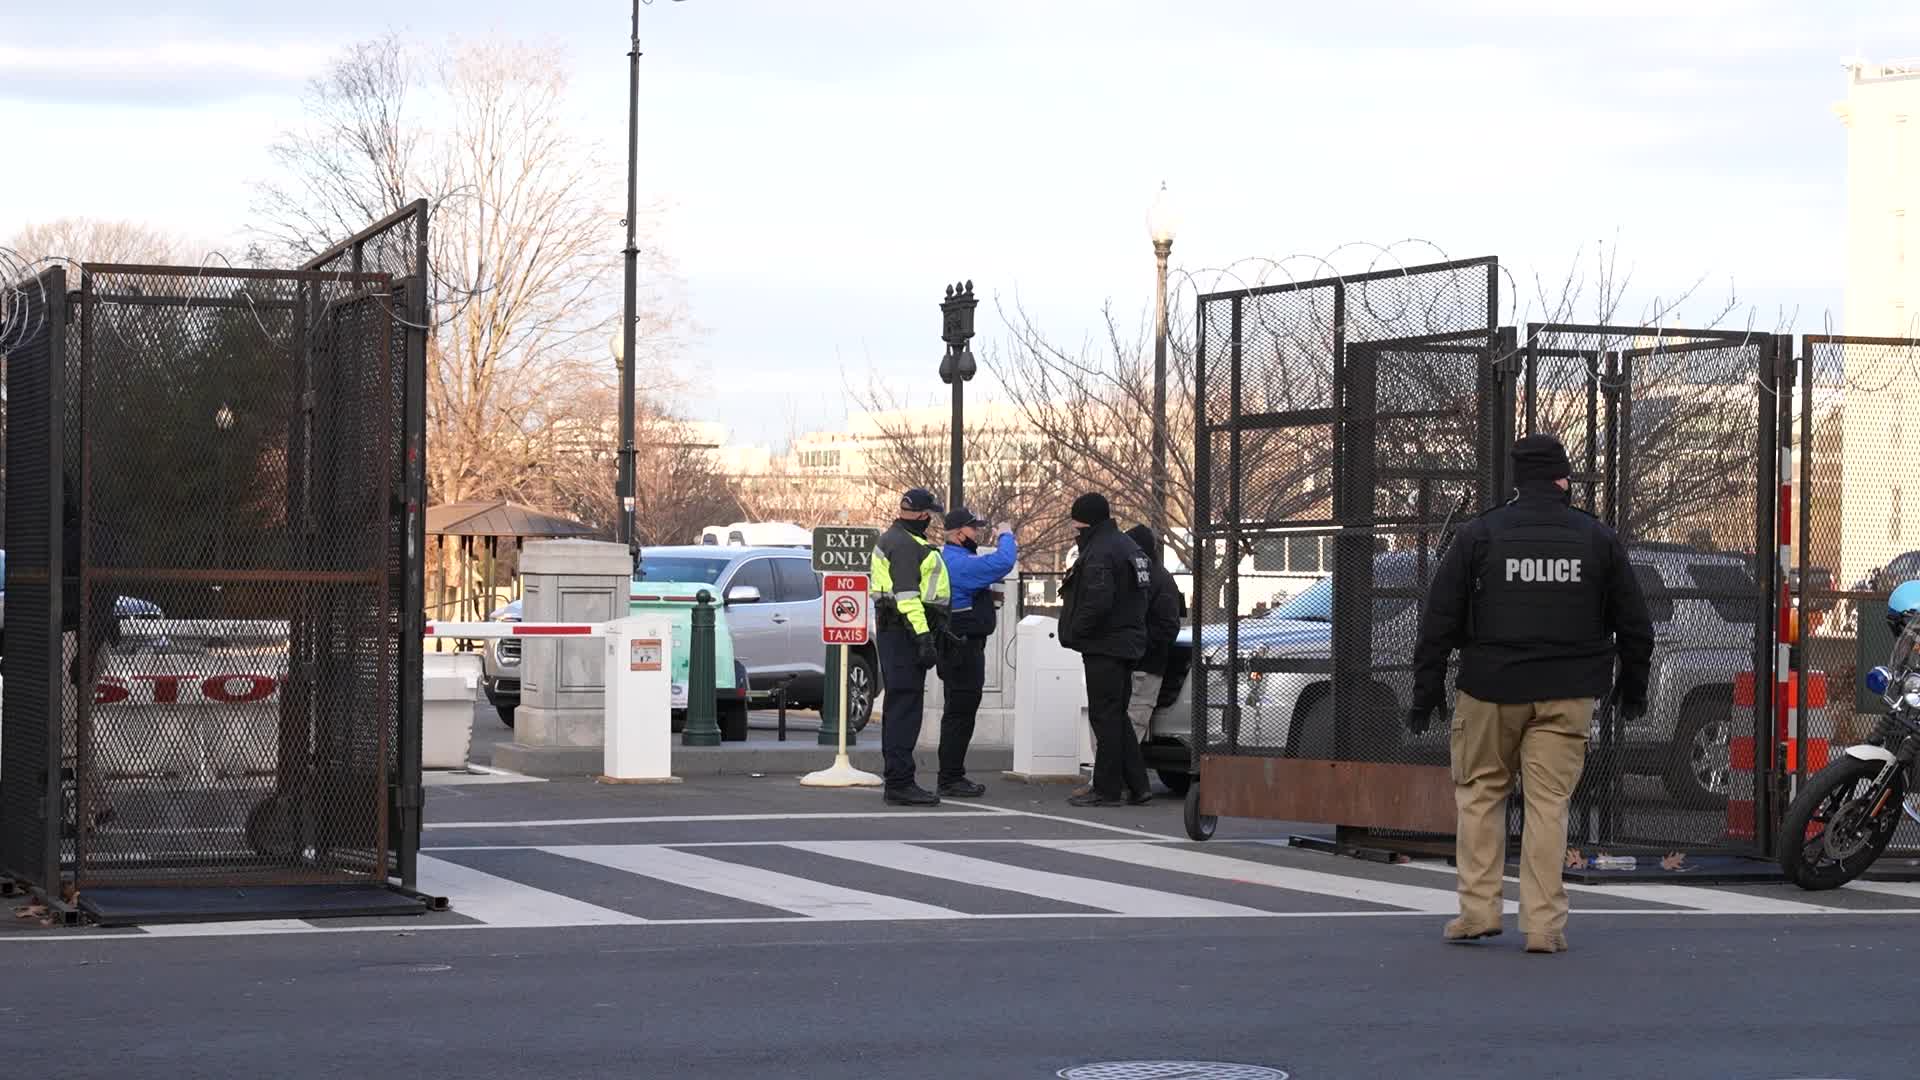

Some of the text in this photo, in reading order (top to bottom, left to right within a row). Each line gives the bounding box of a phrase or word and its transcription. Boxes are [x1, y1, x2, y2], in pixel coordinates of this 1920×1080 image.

[825, 533, 869, 548] EXIT
[820, 551, 871, 566] ONLY
[1505, 558, 1582, 582] POLICE
[837, 578, 855, 590] NO
[828, 629, 863, 641] TAXIS
